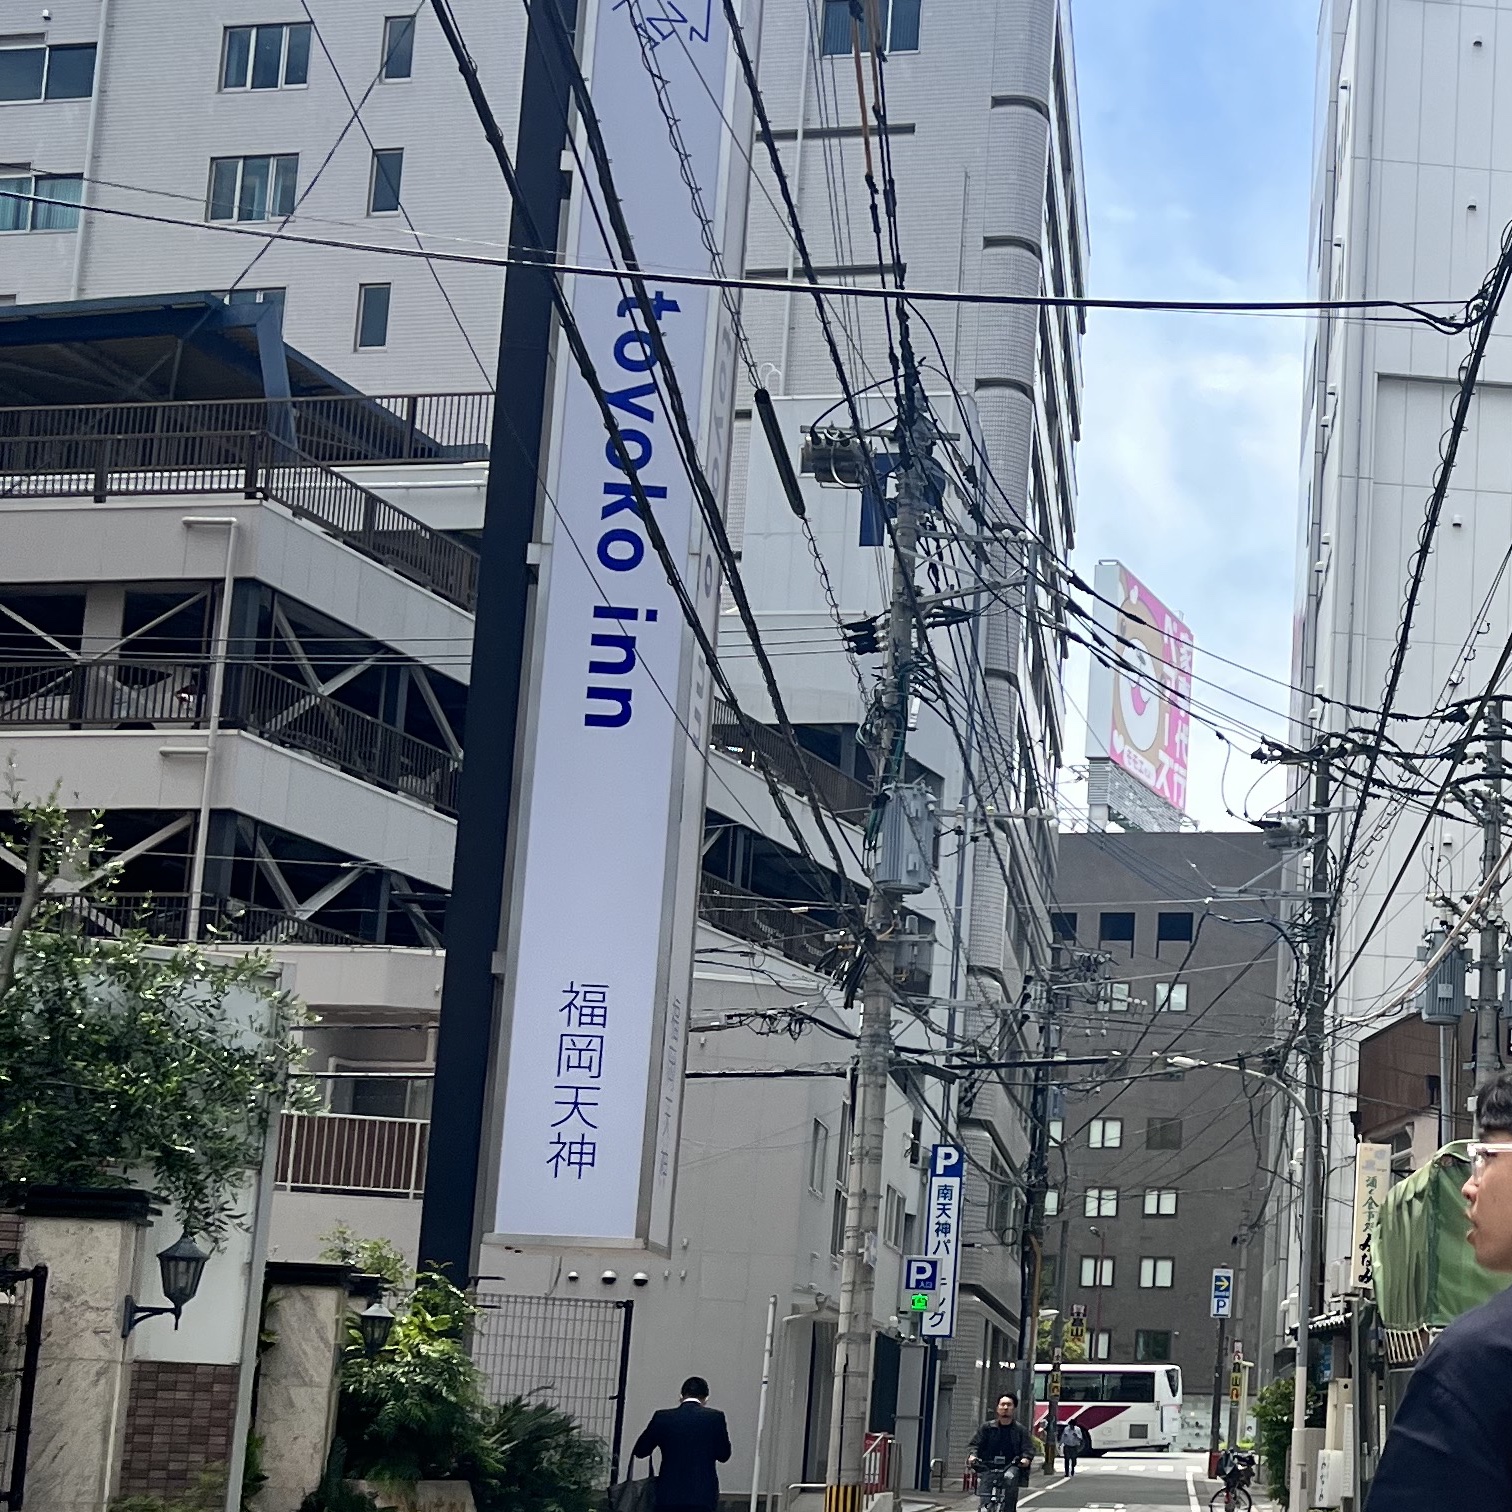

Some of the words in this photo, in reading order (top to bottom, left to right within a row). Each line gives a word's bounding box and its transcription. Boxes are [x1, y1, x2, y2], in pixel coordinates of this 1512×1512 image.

[597, 290, 681, 572] toyoko
[705, 326, 732, 599] toyoo
[584, 604, 658, 729] inn
[546, 980, 610, 1180] 福岡天神
[936, 1146, 960, 1175] P
[910, 1261, 932, 1288] P
[929, 1184, 954, 1328] 南天神パグ
[1216, 1299, 1227, 1313] P
